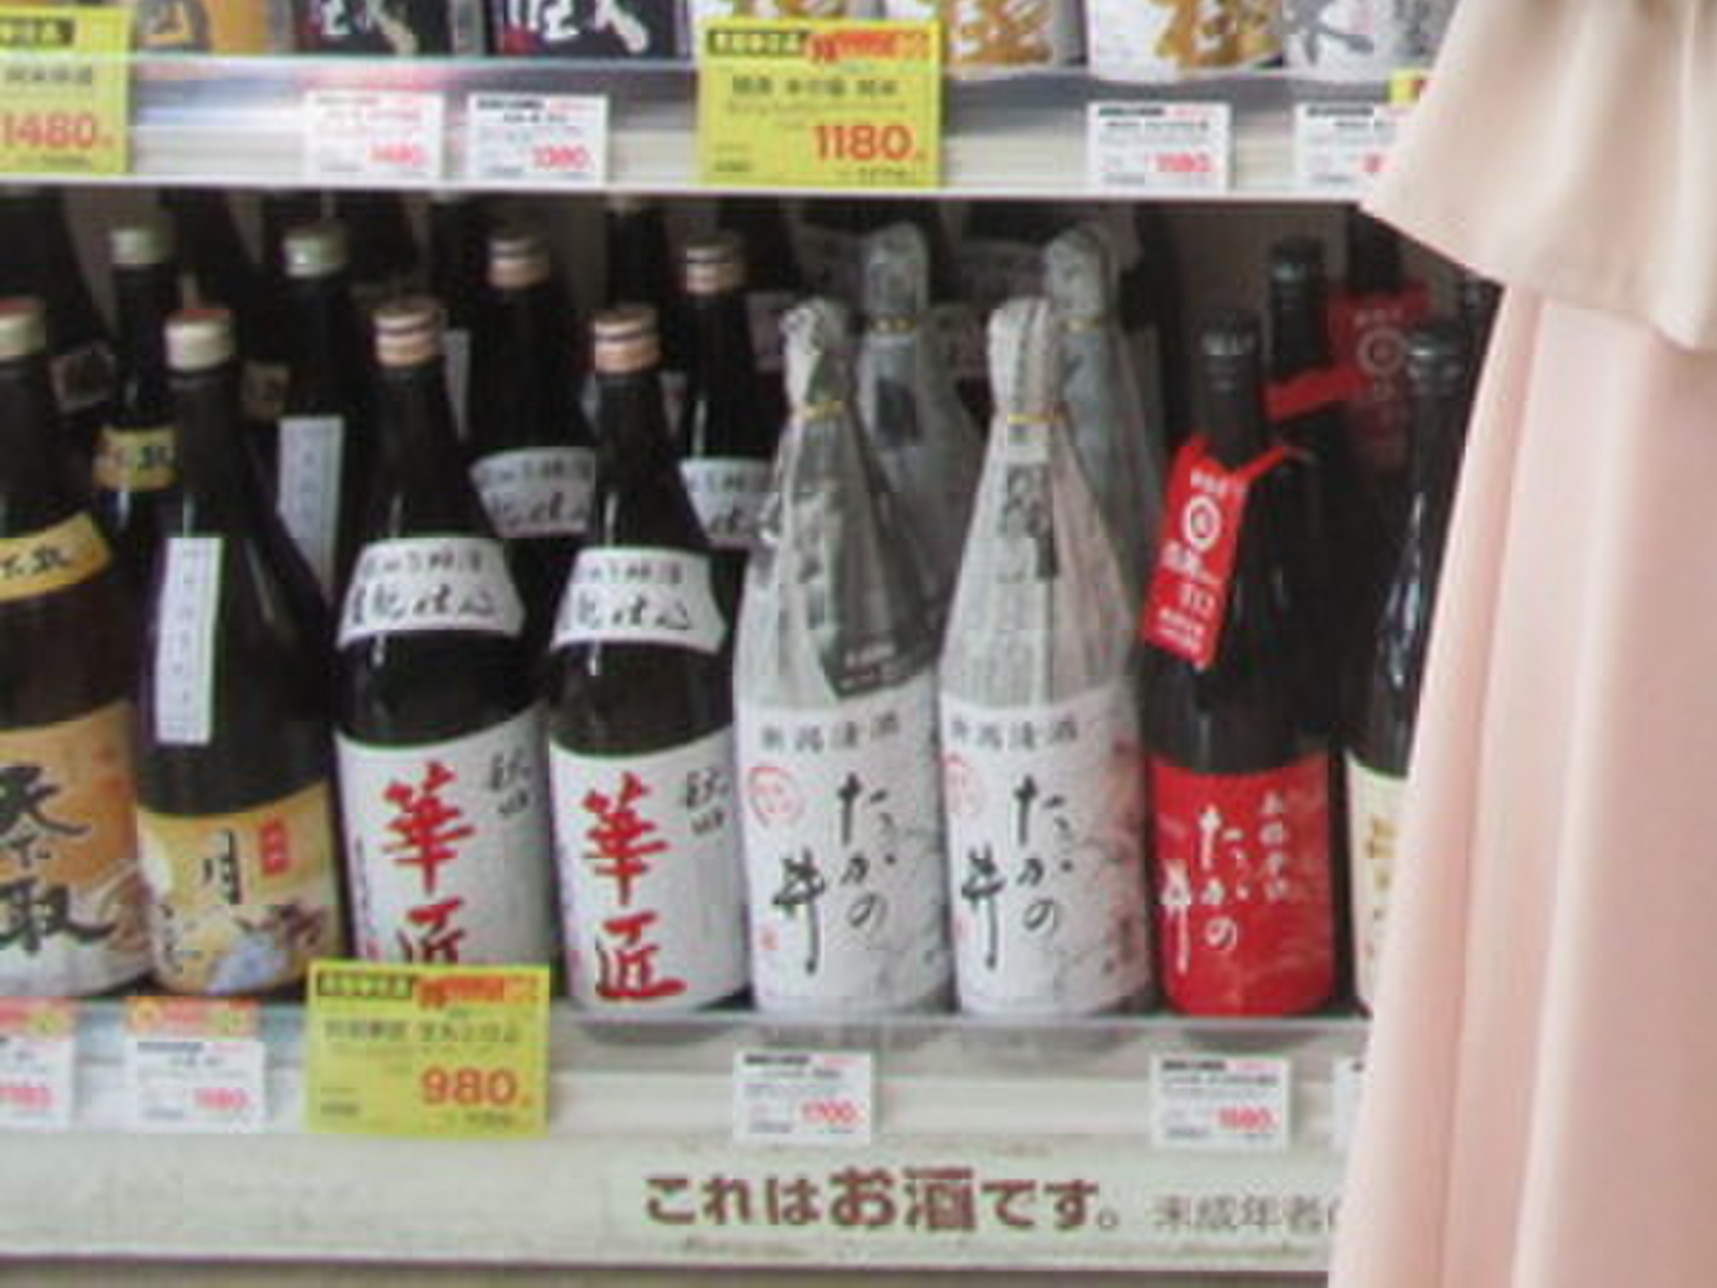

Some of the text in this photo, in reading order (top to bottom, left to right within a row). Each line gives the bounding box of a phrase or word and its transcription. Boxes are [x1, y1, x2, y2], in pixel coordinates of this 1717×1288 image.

[814, 126, 911, 163] 1180
[583, 773, 688, 1001] 華匠
[420, 1065, 517, 1107] 980
[646, 1166, 1120, 1231] これはお酒です。
